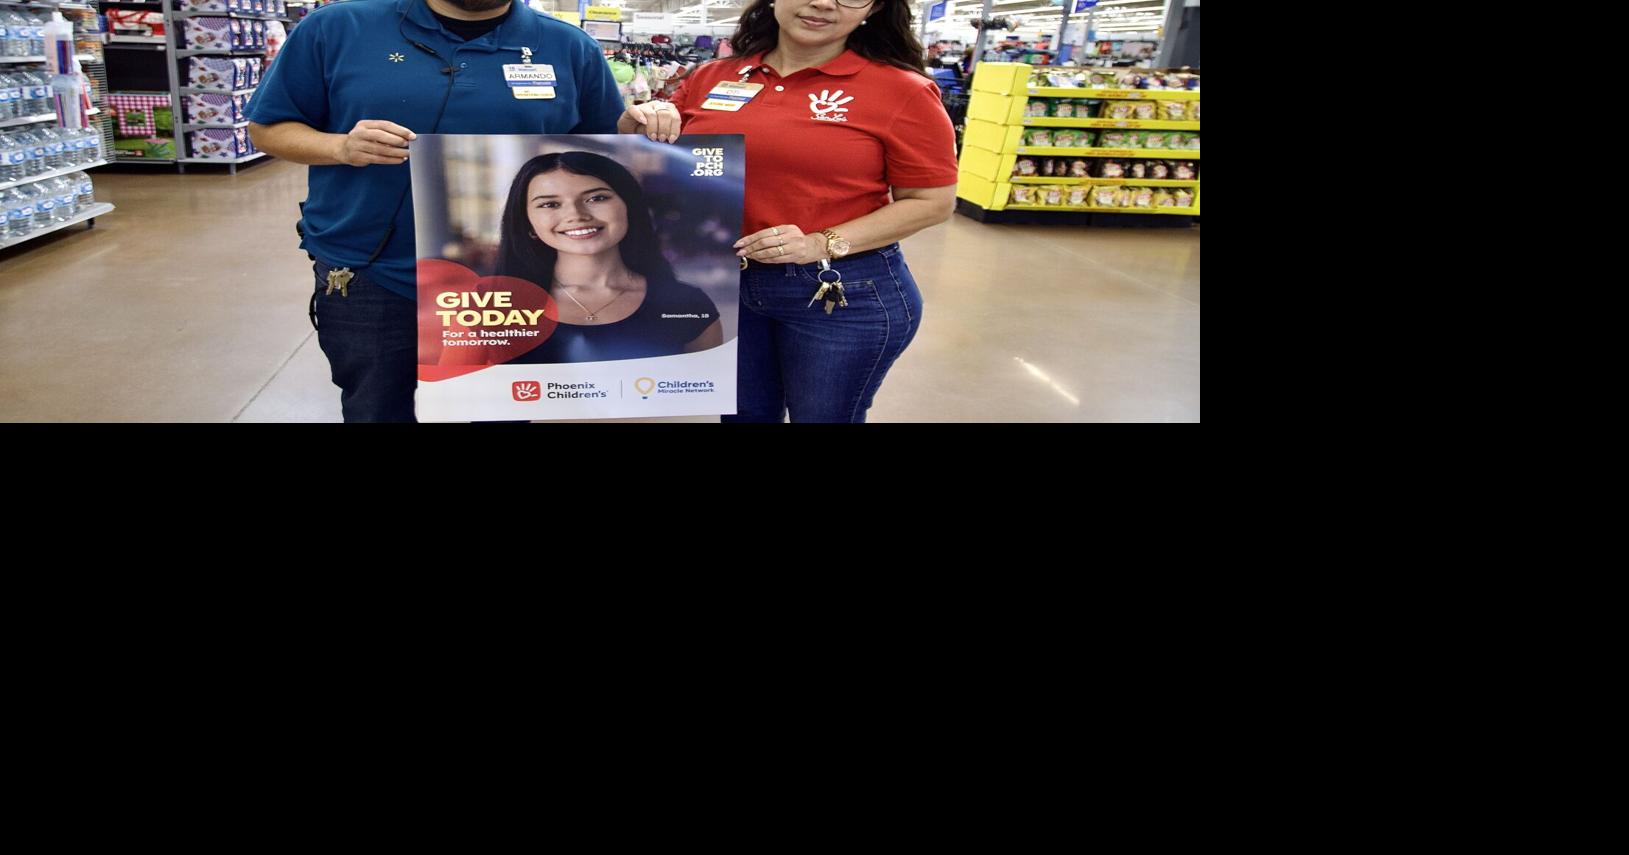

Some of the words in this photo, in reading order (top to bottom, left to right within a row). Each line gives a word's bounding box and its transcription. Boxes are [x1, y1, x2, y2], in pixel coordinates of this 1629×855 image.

[692, 147, 724, 156] GIVE
[704, 155, 724, 163] TO
[696, 162, 724, 170] PCH
[690, 169, 724, 177] .ORG
[436, 291, 512, 309] GIVE
[436, 309, 545, 327] TODAY
[443, 330, 464, 338] For
[480, 328, 540, 338] healthier
[547, 382, 596, 390] Phoenix
[657, 380, 714, 388] Children's
[547, 390, 608, 399] Children's
